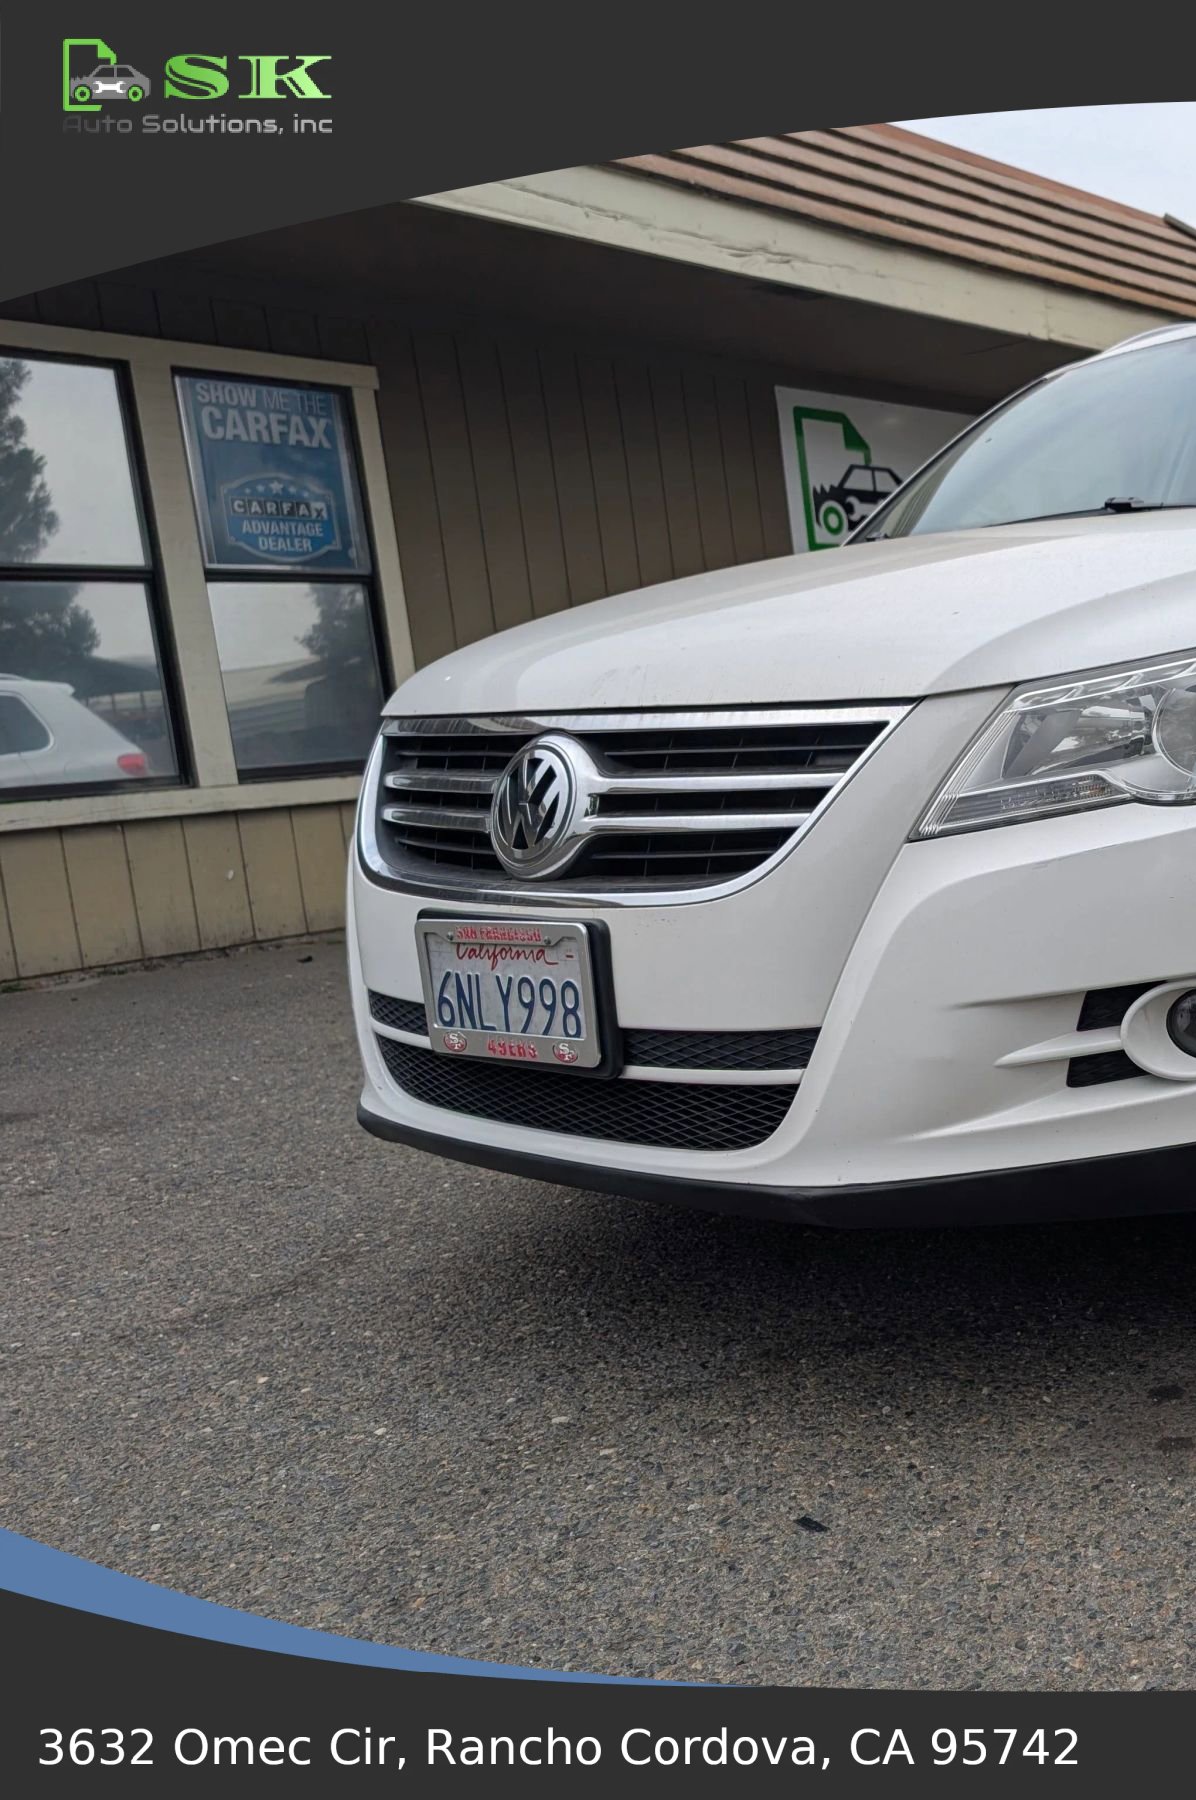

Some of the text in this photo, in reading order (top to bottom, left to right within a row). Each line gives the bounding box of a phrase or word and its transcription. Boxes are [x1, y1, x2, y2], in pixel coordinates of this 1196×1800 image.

[196, 383, 326, 415] SHOW ME THE
[201, 406, 332, 449] CARFAX
[233, 500, 327, 520] CARFAX
[242, 519, 323, 536] ADVANTAGE
[258, 537, 312, 552] DEALER
[456, 943, 559, 971] California
[437, 971, 582, 1038] 6NLY998
